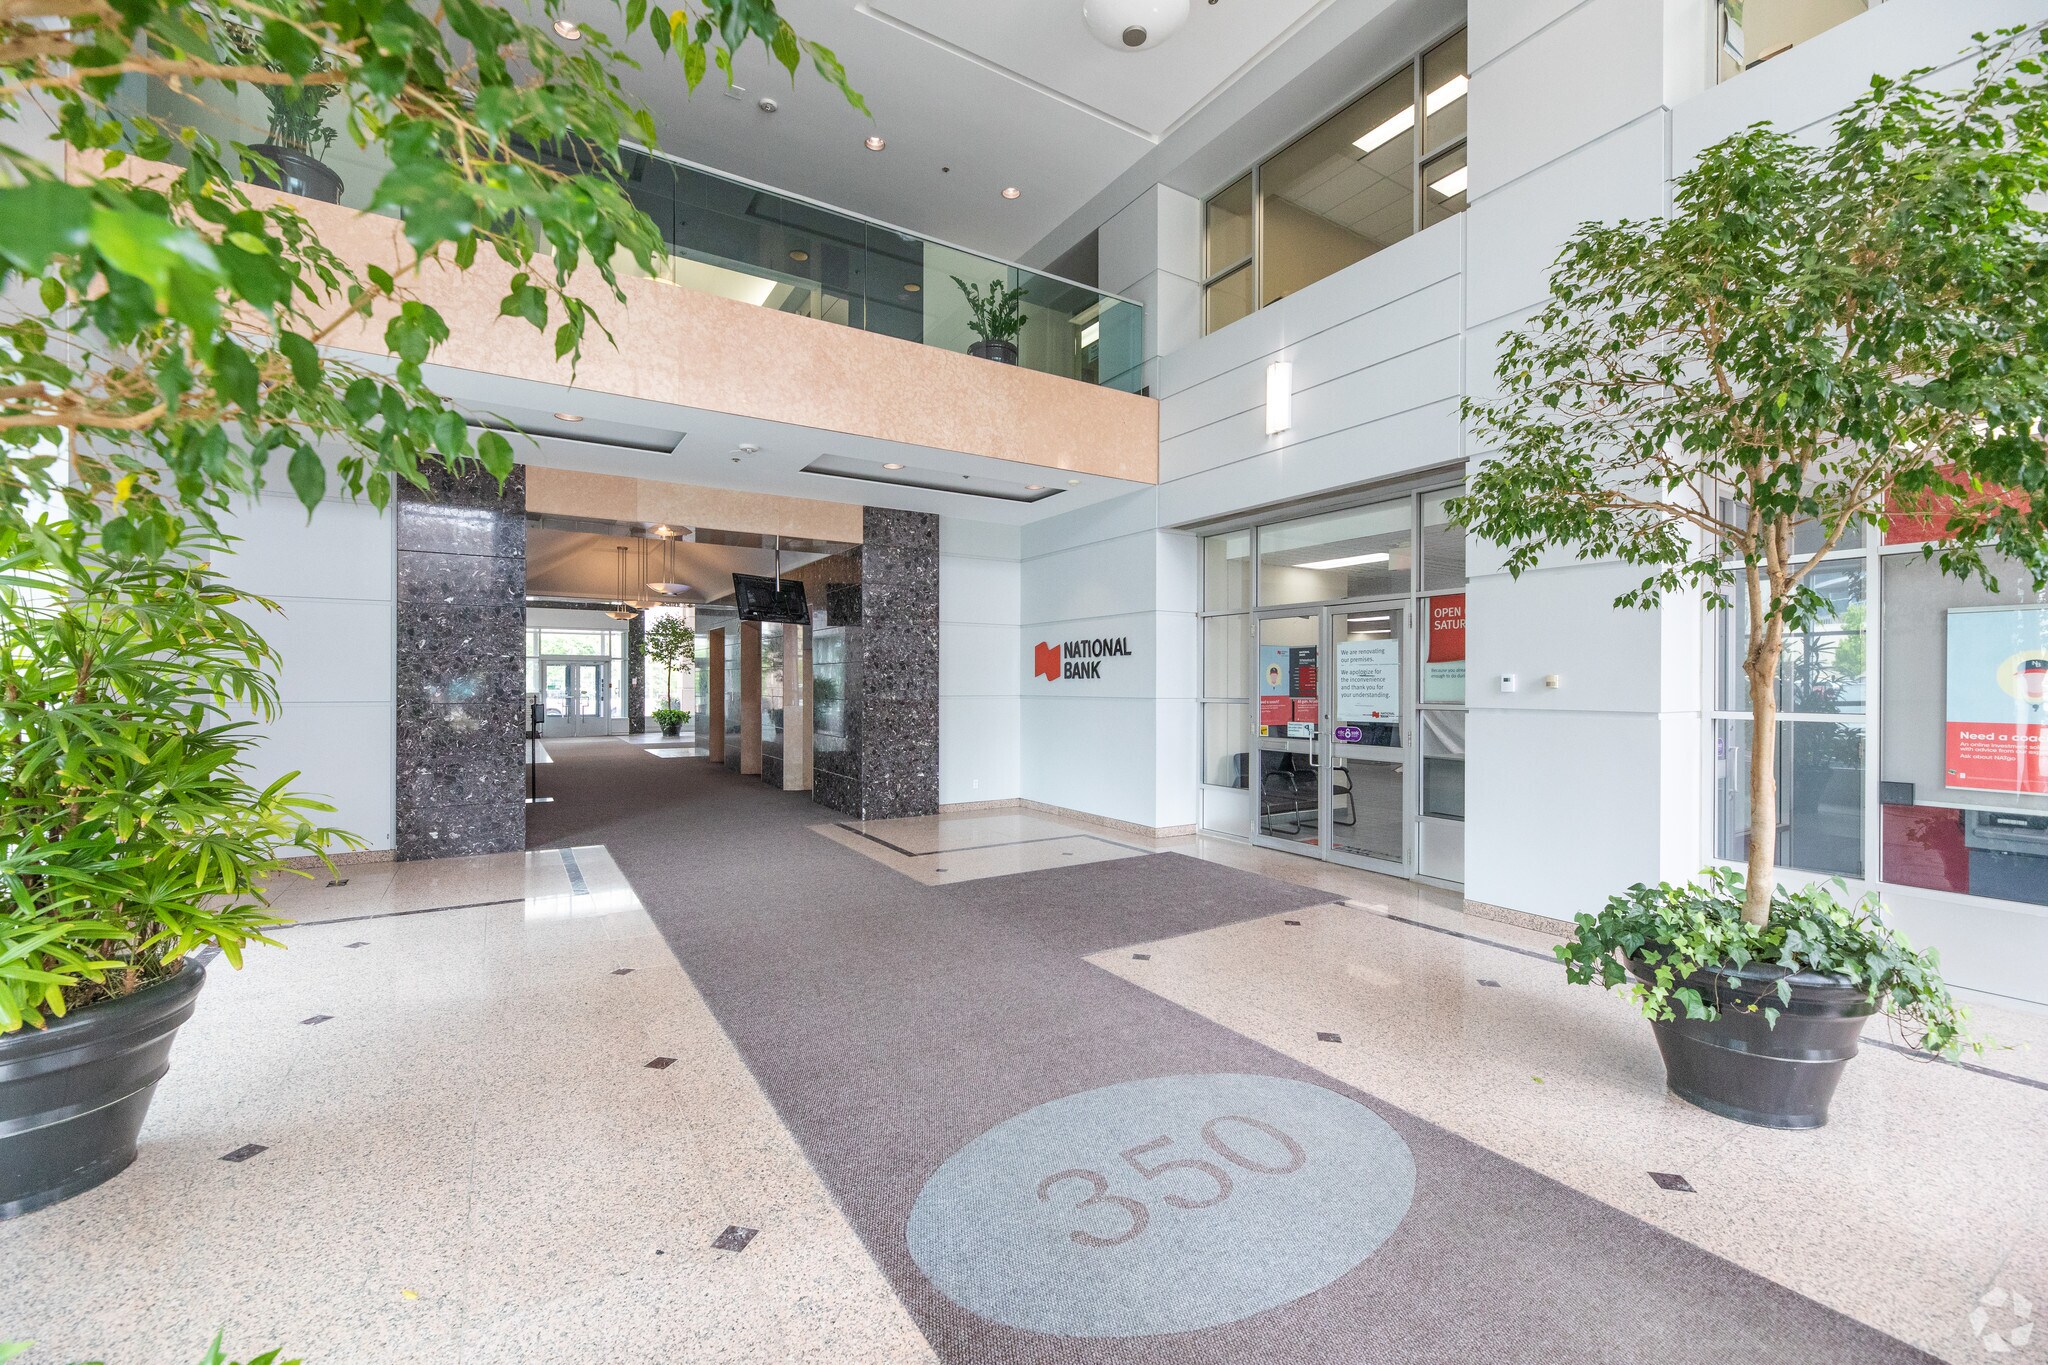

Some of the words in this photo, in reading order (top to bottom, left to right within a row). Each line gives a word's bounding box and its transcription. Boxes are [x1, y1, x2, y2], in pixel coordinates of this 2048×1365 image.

[1434, 606, 1461, 618] OPEN
[1064, 637, 1132, 659] NATIONAL
[1064, 661, 1101, 680] BANK
[1960, 732, 1994, 740] Need
[2012, 734, 2048, 742] coac
[1037, 1115, 1307, 1248] 350
